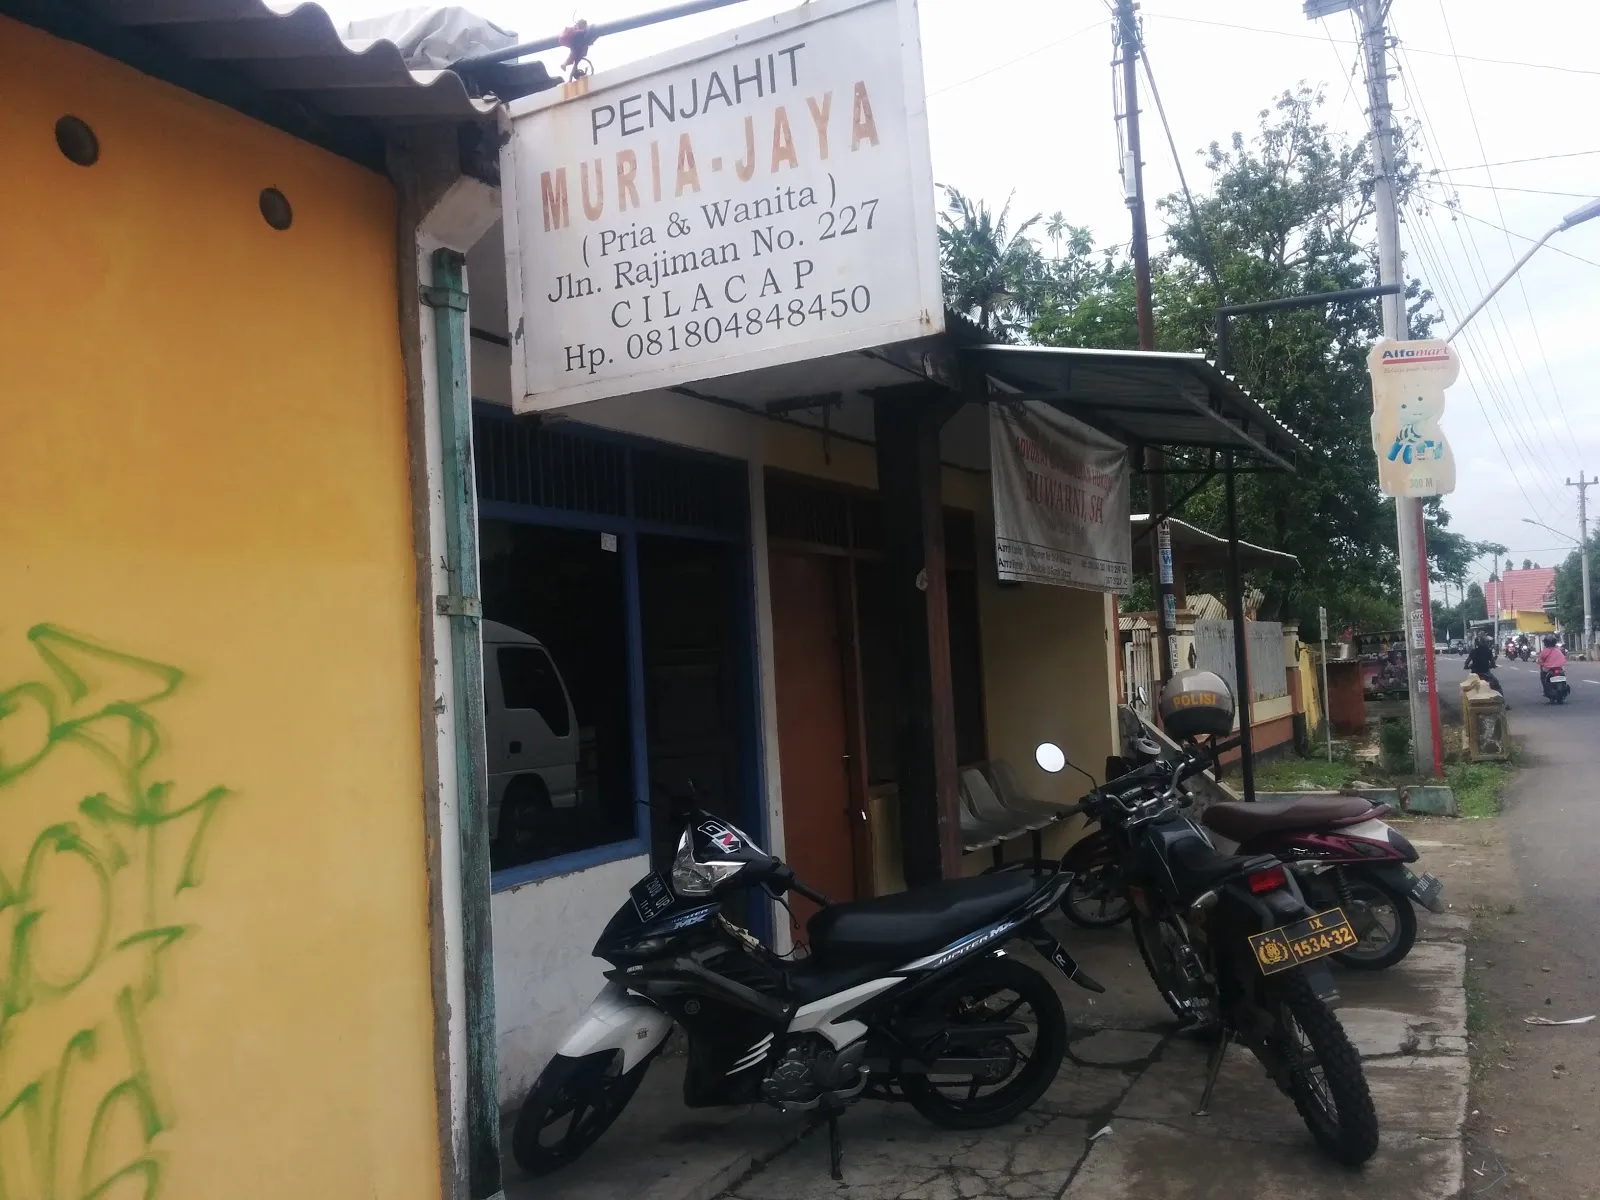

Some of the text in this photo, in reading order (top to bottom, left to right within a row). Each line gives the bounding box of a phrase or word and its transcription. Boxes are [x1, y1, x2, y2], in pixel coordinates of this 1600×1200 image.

[591, 43, 806, 145] PENJAHIT
[540, 80, 879, 232] MURIA-JAYA
[666, 212, 691, 236] &
[548, 199, 879, 304] Jln. Rajiman No. 227
[611, 260, 815, 330] CILACAP
[564, 285, 871, 376] Hp. 081804848450
[1382, 347, 1449, 359] Alfamart
[1172, 692, 1216, 708] POLISI
[933, 919, 1018, 968] JUPITER MX
[1293, 926, 1354, 959] 1534-32
[1308, 917, 1324, 932] IX
